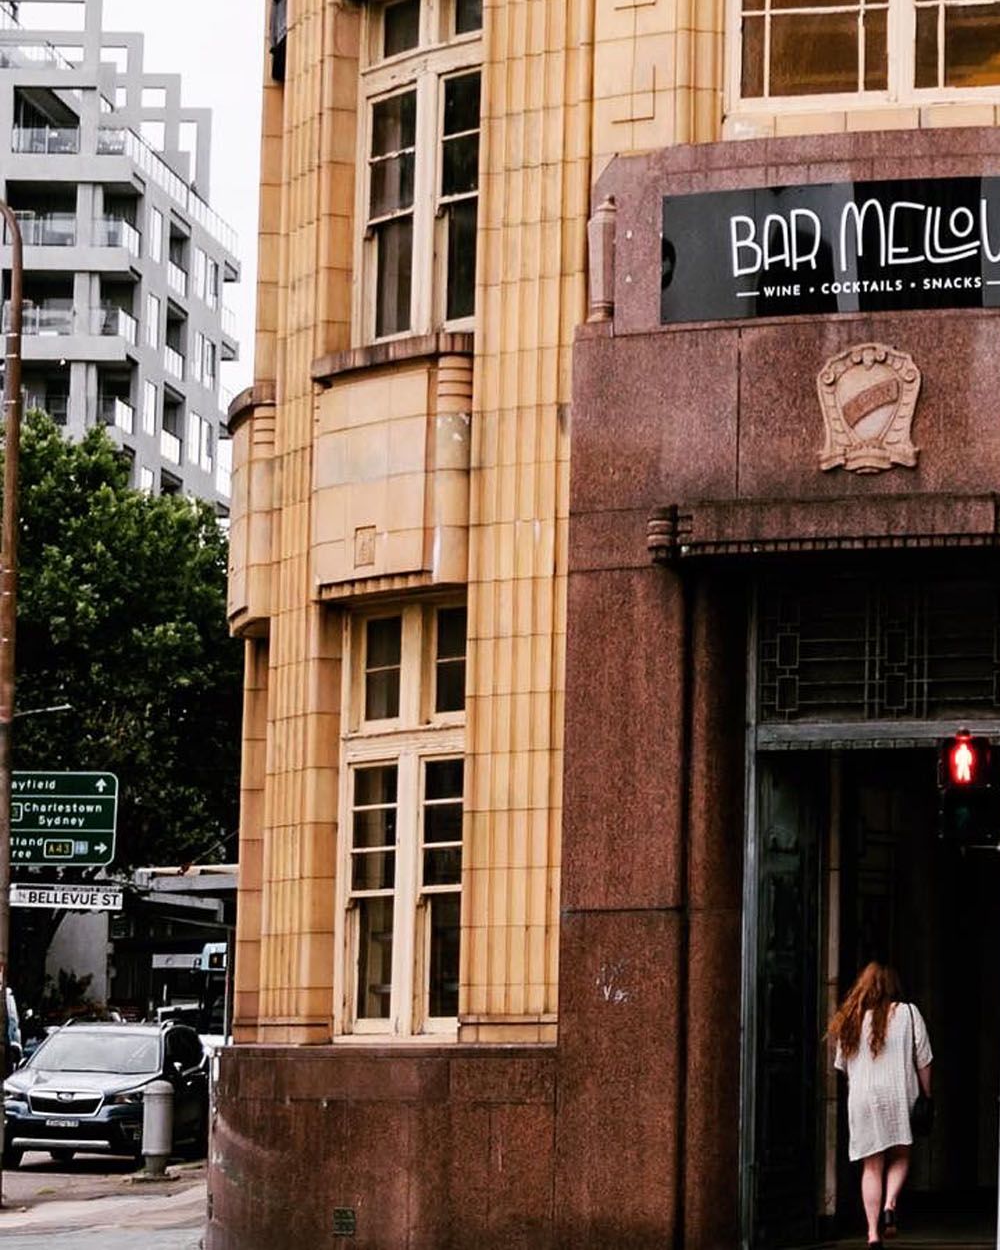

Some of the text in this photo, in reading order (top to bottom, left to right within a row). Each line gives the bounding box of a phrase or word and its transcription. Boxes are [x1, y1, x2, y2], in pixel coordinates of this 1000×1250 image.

[730, 208, 822, 277] BAR
[764, 276, 982, 297] WINE COCKTAILS SNACKS
[11, 779, 56, 791] ayfield
[24, 802, 102, 813] Charlestown
[39, 815, 85, 827] Sydney
[28, 891, 98, 906] BELLEVUE
[102, 893, 120, 906] ST
